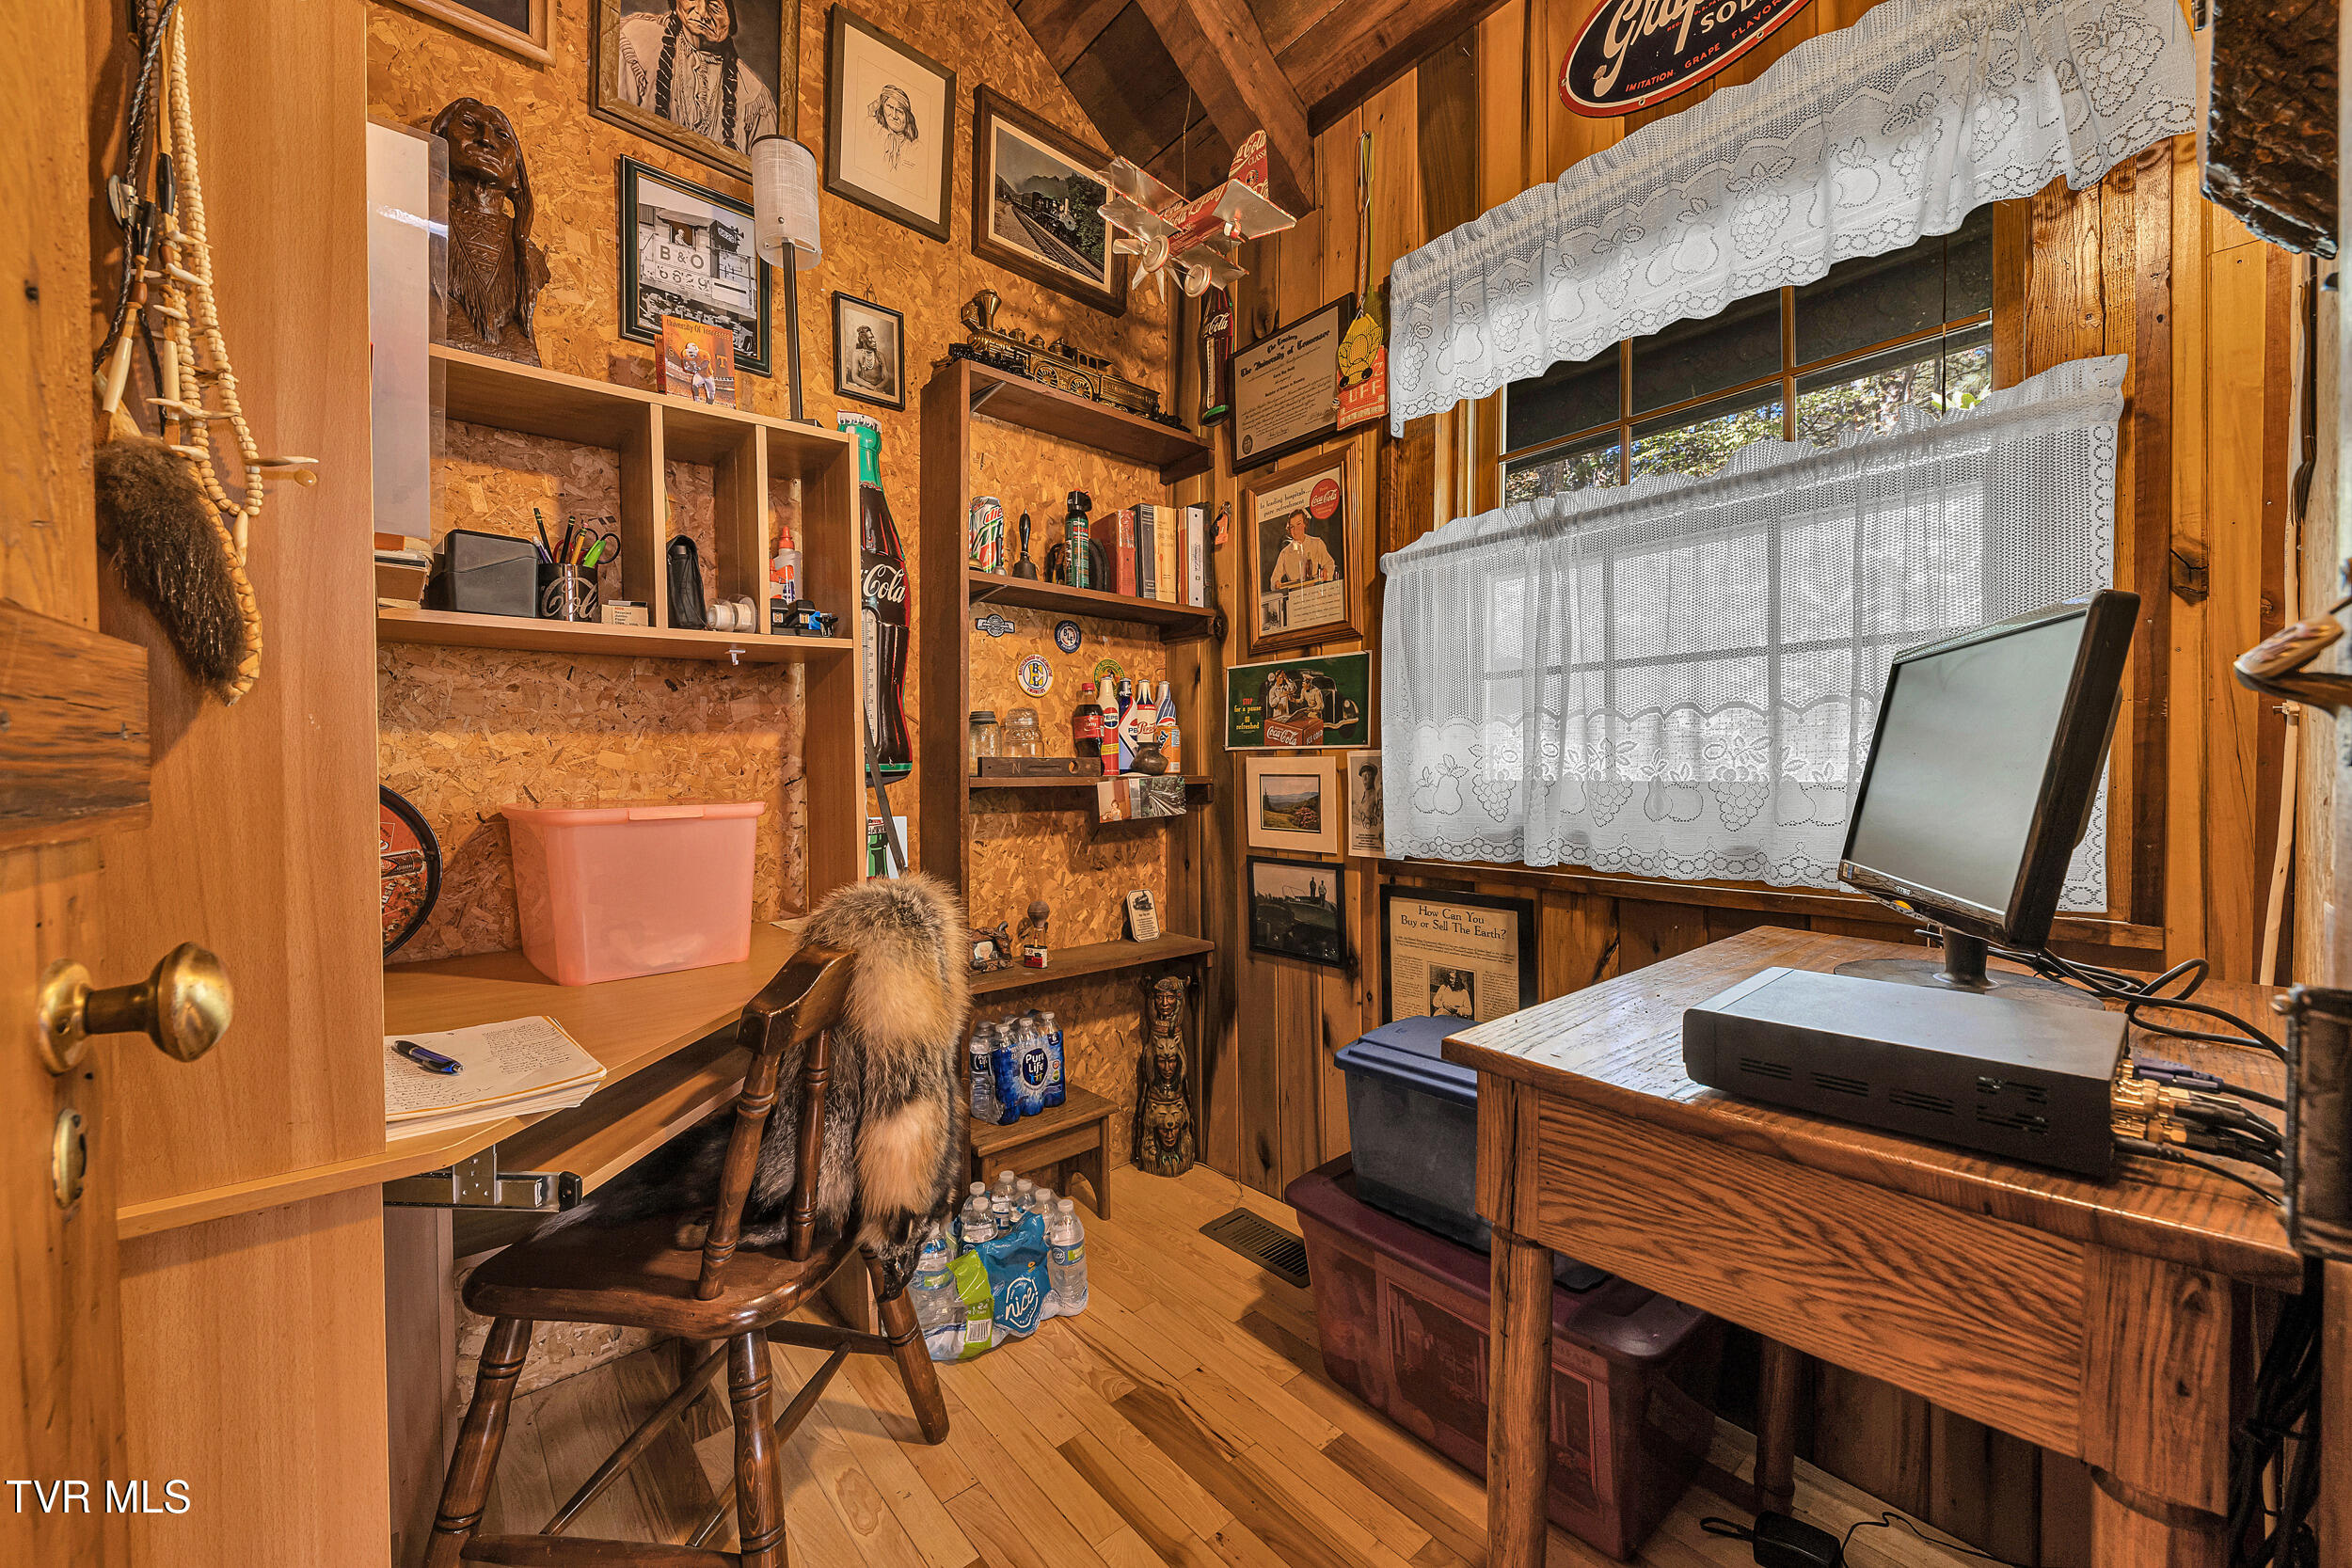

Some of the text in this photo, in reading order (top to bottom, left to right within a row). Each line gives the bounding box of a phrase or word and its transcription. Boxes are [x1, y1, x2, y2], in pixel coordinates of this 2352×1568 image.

[1625, 0, 1783, 92] IMITATION GRAPE FLAVOR
[660, 245, 671, 261] B
[690, 254, 705, 270] O
[716, 355, 728, 369] T
[1247, 705, 1262, 714] pause
[1235, 721, 1260, 730] refreshed
[1419, 904, 1485, 924] How Can You
[1401, 914, 1418, 927] Buy
[1432, 919, 1448, 931] Sell
[1452, 922, 1470, 935] The
[1474, 925, 1507, 941] Earth?
[1028, 1063, 1043, 1074] Life
[1005, 1286, 1036, 1321] nice
